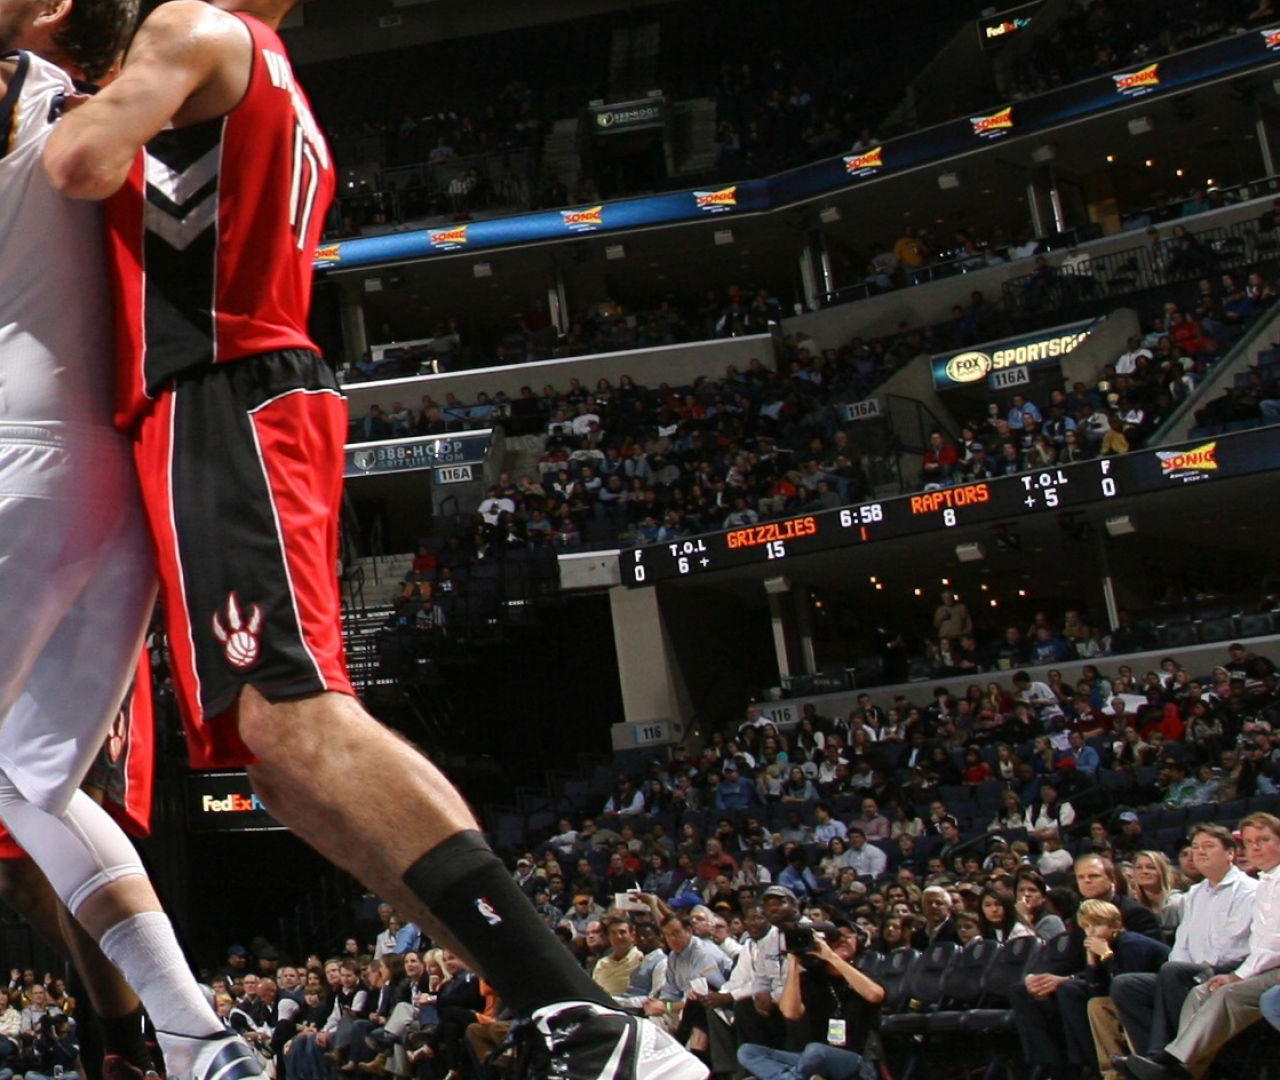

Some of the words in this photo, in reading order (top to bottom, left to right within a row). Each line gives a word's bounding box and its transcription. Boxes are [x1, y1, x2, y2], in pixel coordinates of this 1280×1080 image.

[955, 357, 980, 372] FOX
[995, 372, 1026, 387] 116A
[849, 401, 878, 418] 116A
[1164, 449, 1215, 467] SONIC
[442, 467, 471, 481] 116A
[1100, 460, 1110, 474] F
[1102, 478, 1115, 497] 0
[910, 484, 989, 514] RAPTORS
[1045, 488, 1059, 508] 5
[840, 503, 883, 528] 6:58
[943, 508, 956, 527] 8
[726, 516, 817, 549] GRIZZLIES
[635, 549, 642, 562] F
[766, 541, 786, 560] 15
[634, 565, 645, 581] 0
[678, 558, 689, 574] 6
[771, 707, 791, 721] 116
[643, 726, 662, 740] 116
